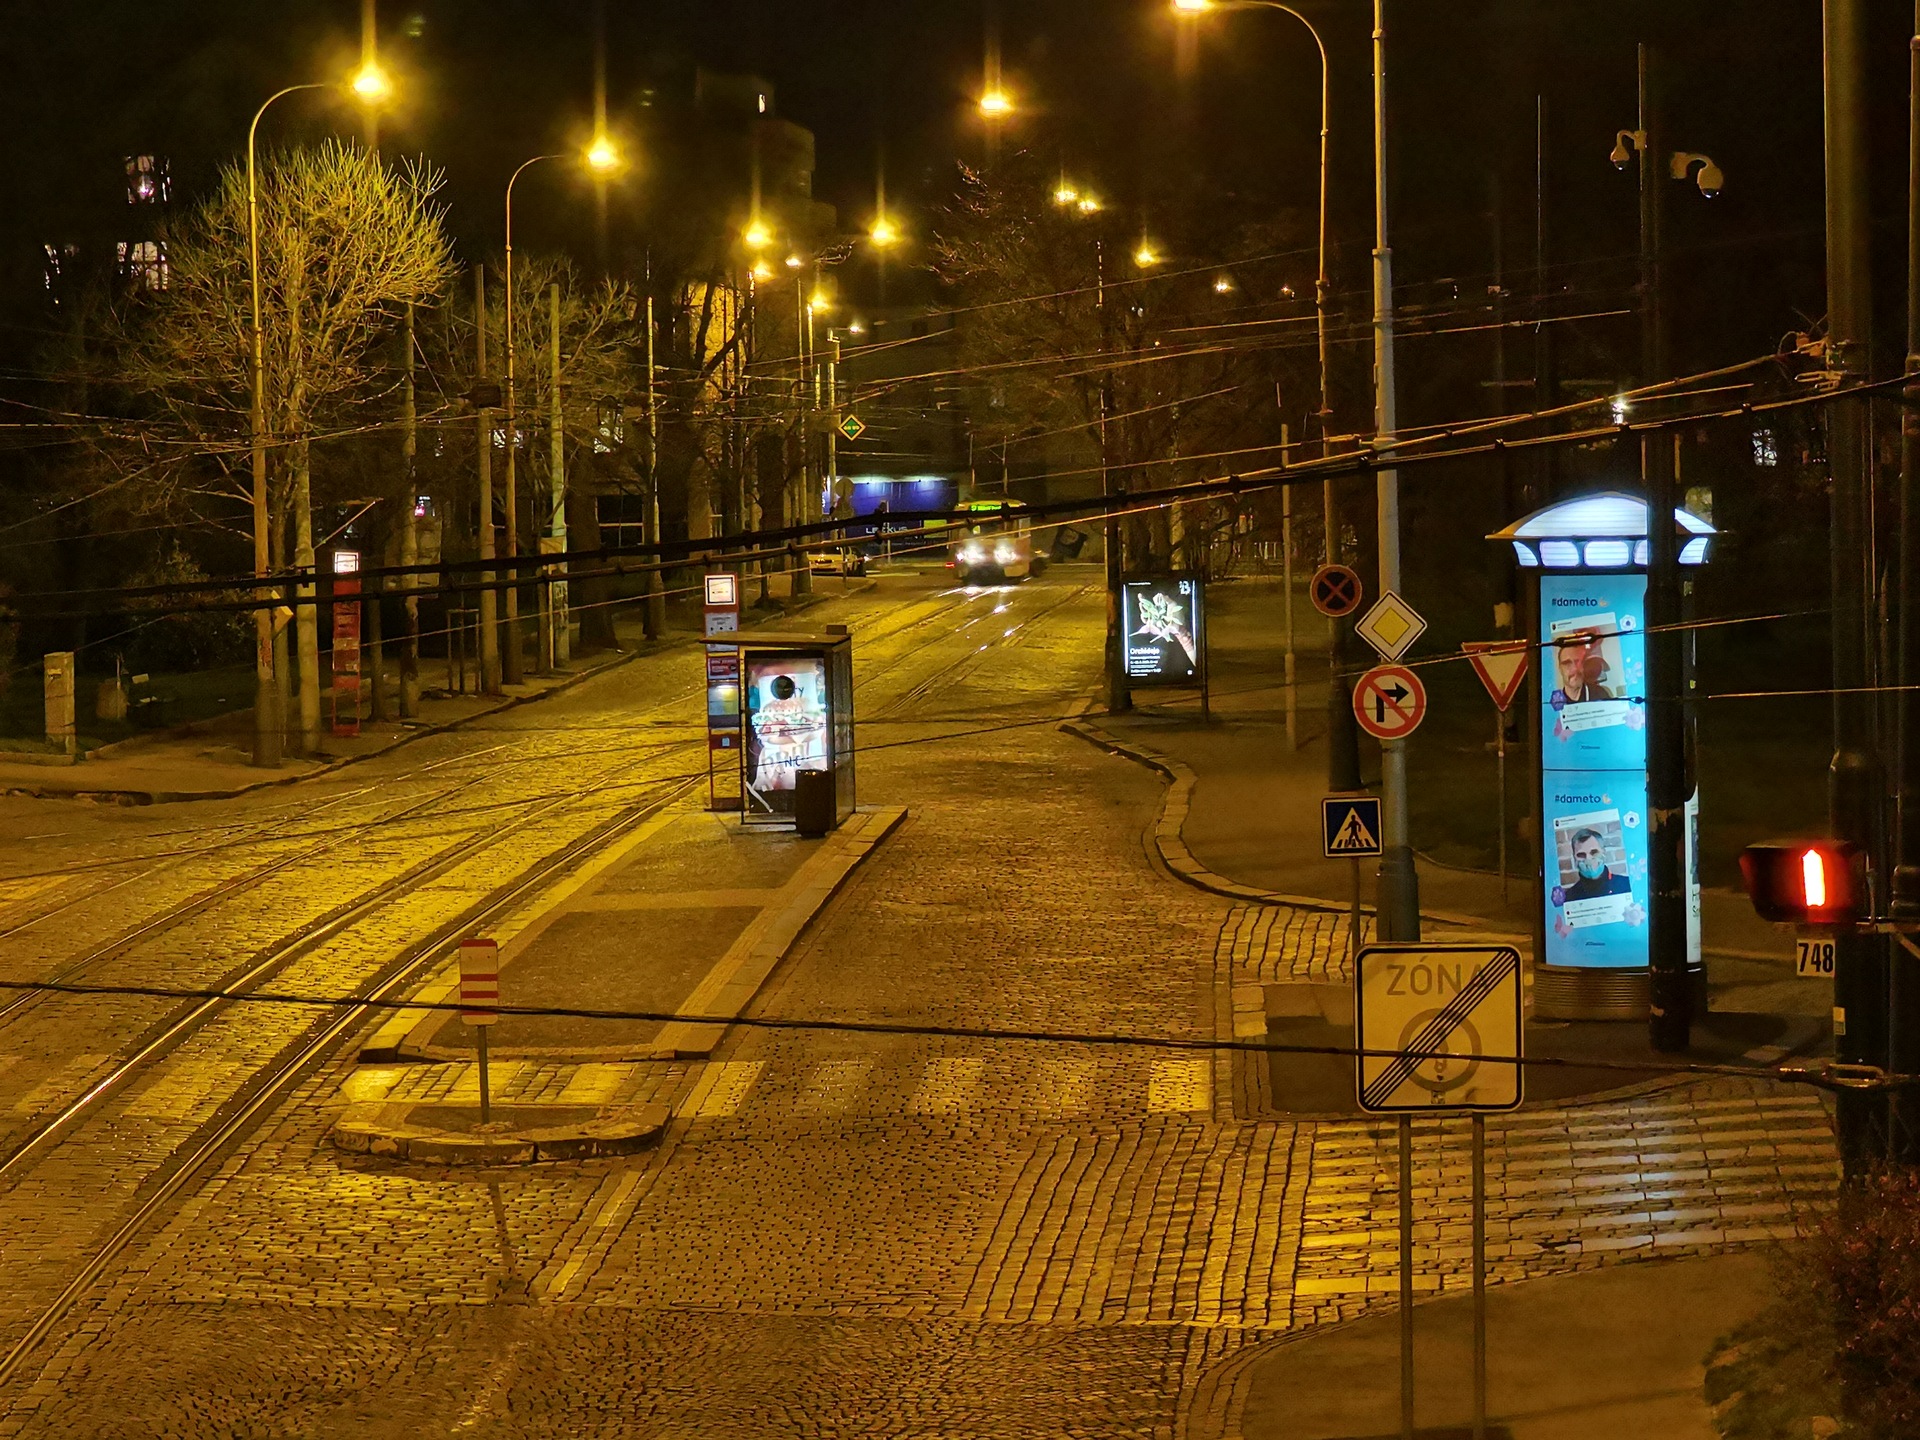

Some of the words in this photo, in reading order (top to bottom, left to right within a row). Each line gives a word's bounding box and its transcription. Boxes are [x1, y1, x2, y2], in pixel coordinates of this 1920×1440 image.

[1551, 597, 1598, 607] #dameto
[1555, 794, 1601, 804] #dameto
[1797, 942, 1834, 973] 748
